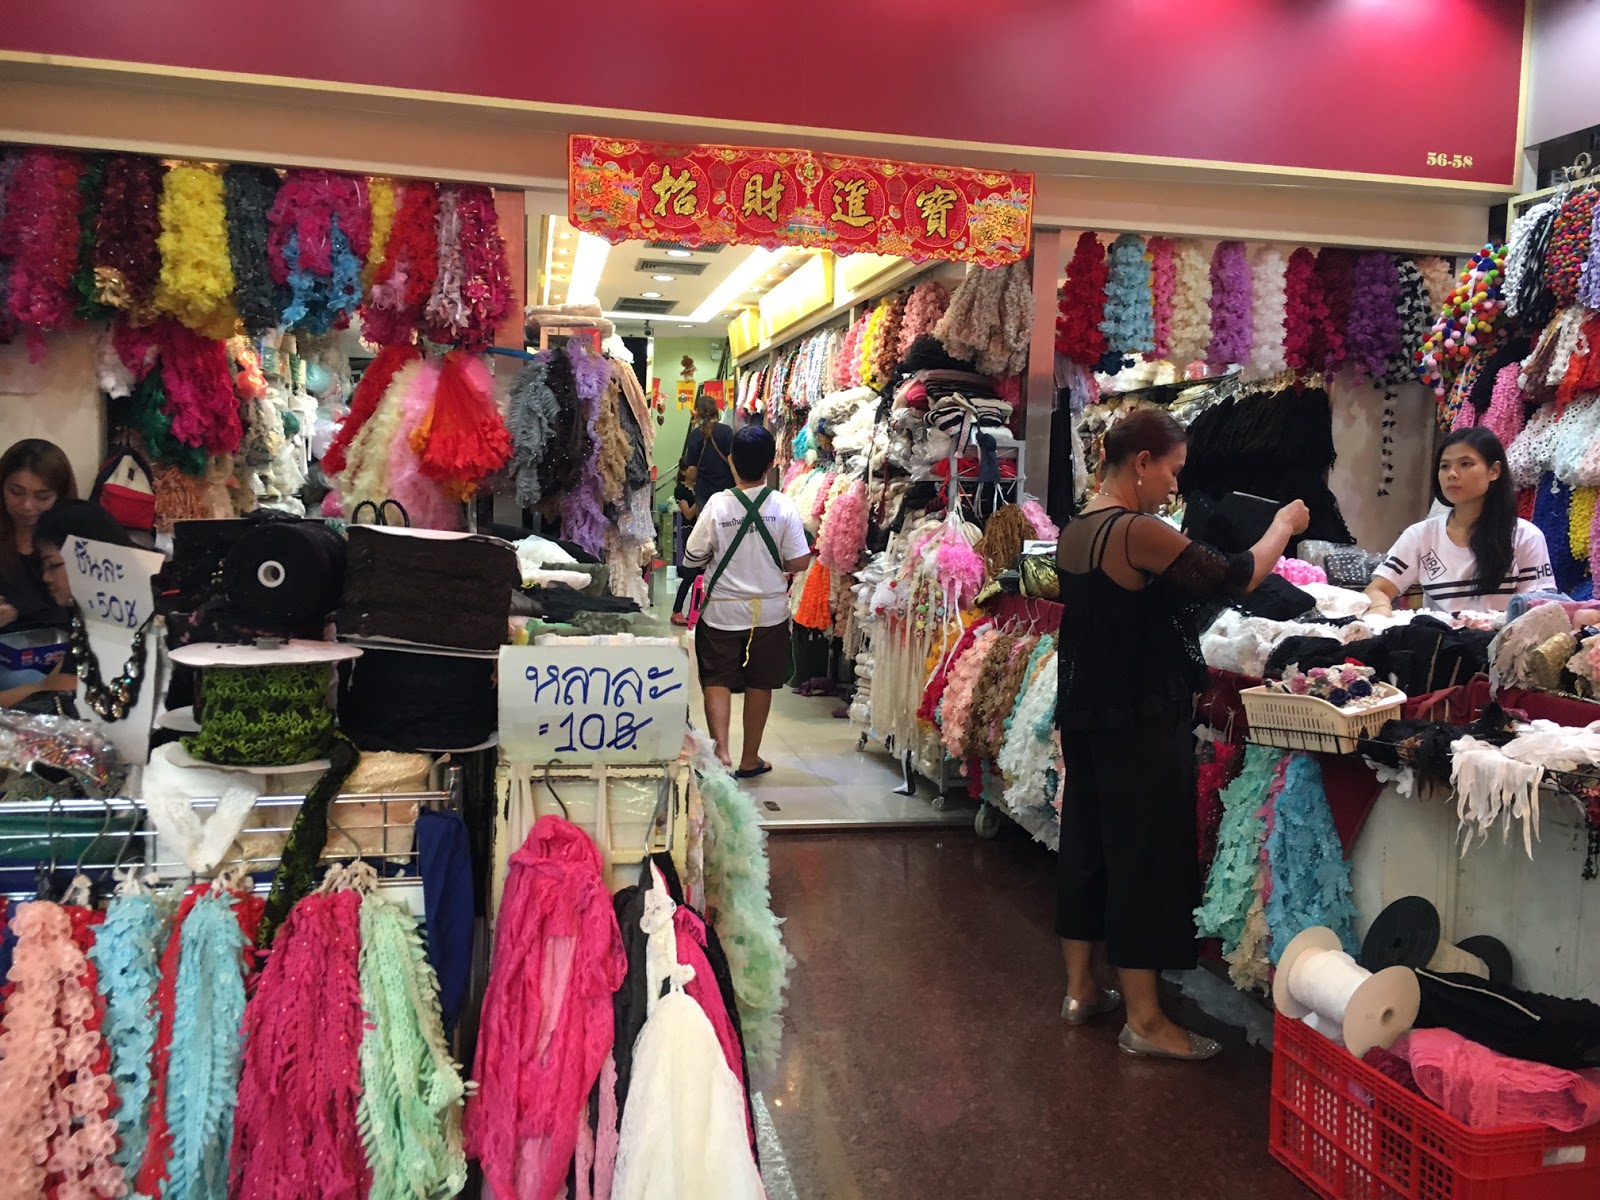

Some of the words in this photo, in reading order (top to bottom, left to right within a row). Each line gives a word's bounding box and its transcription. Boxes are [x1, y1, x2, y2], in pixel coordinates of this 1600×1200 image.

[1426, 151, 1473, 168] 56-58
[651, 164, 958, 239] 招財進寶
[525, 665, 682, 707] หลาละ
